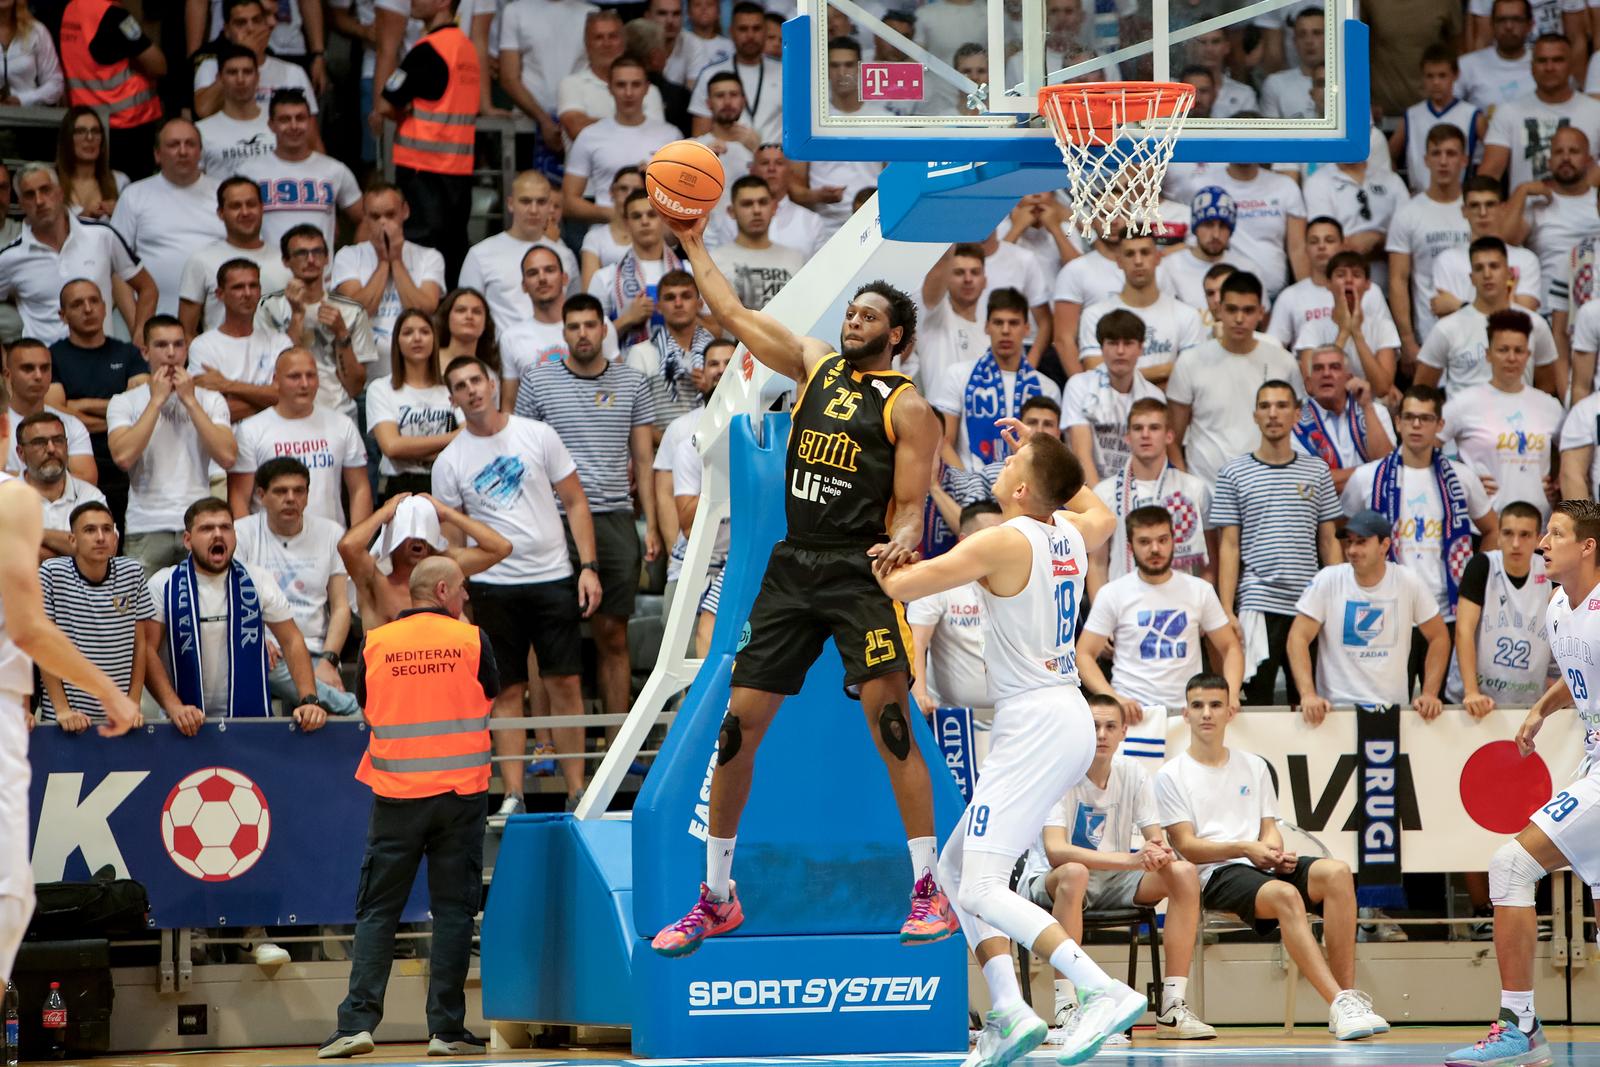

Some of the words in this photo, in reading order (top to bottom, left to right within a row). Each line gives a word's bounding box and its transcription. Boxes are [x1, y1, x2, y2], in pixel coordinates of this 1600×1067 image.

[653, 186, 703, 216] Wilson
[824, 387, 863, 422] 25
[798, 429, 862, 472] split
[236, 560, 260, 649] ADAR
[1054, 580, 1075, 647] 19
[385, 649, 461, 664] MEDITERAN
[865, 628, 897, 667] 25
[1360, 650, 1389, 658] ZADAR
[1494, 636, 1532, 670] 22
[391, 662, 456, 677] SECURITY
[1567, 667, 1589, 700] 29
[1364, 740, 1395, 864] DRUGI
[1542, 791, 1579, 822] 29
[967, 805, 990, 837] 19
